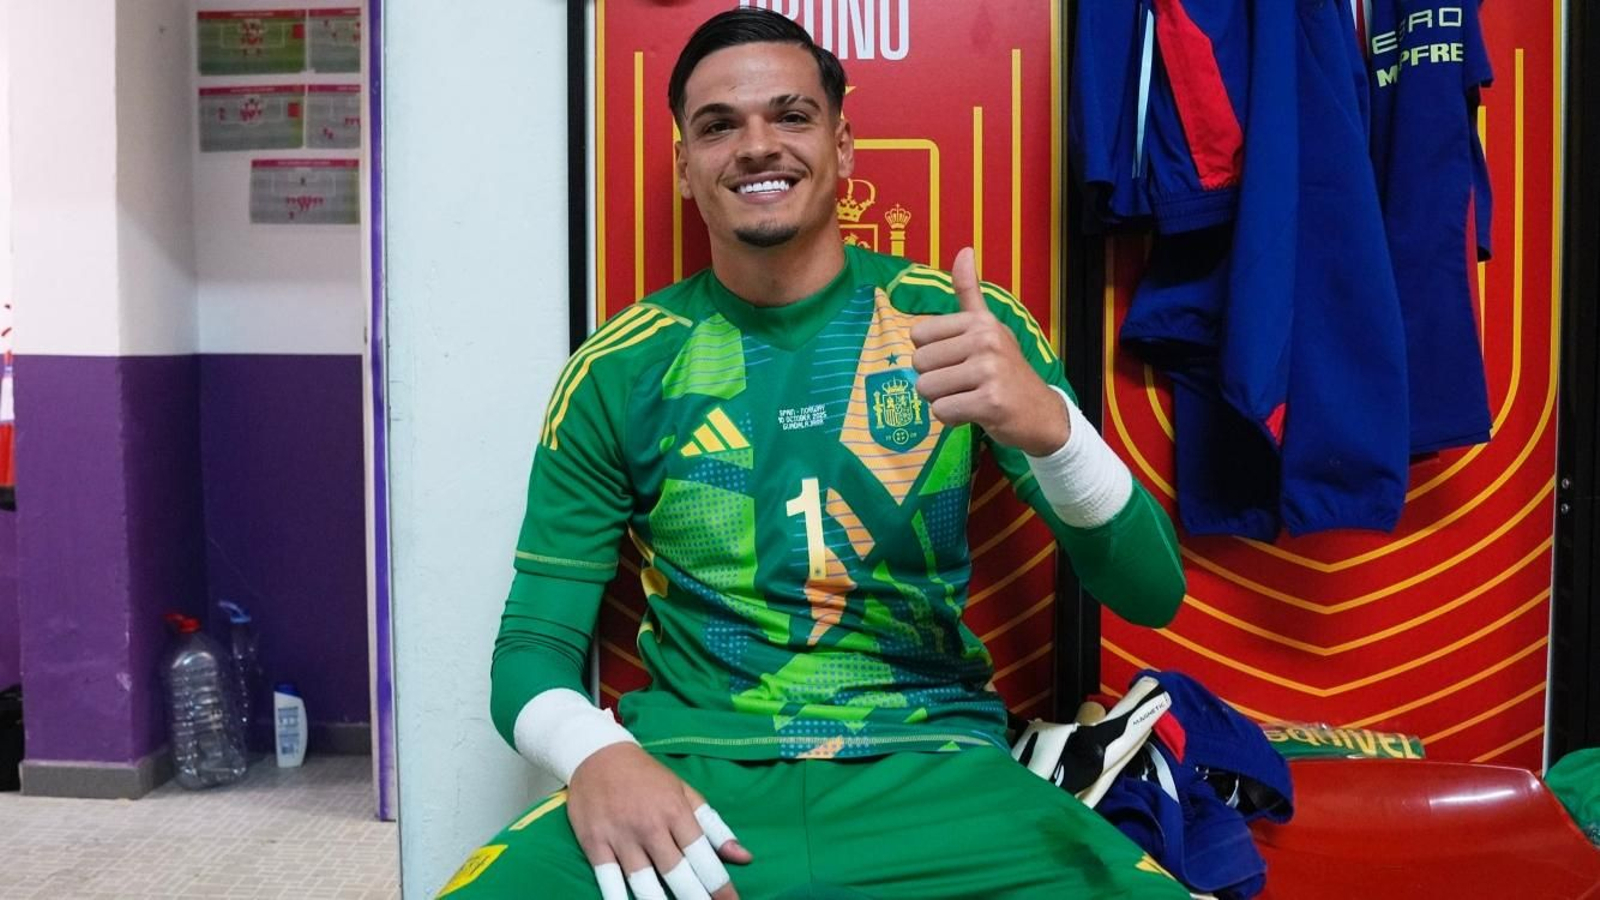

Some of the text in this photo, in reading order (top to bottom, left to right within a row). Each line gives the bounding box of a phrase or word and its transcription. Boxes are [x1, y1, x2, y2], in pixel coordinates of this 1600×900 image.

[1372, 7, 1462, 54] ERO
[1377, 43, 1464, 87] MPFRE
[786, 477, 827, 580] 1
